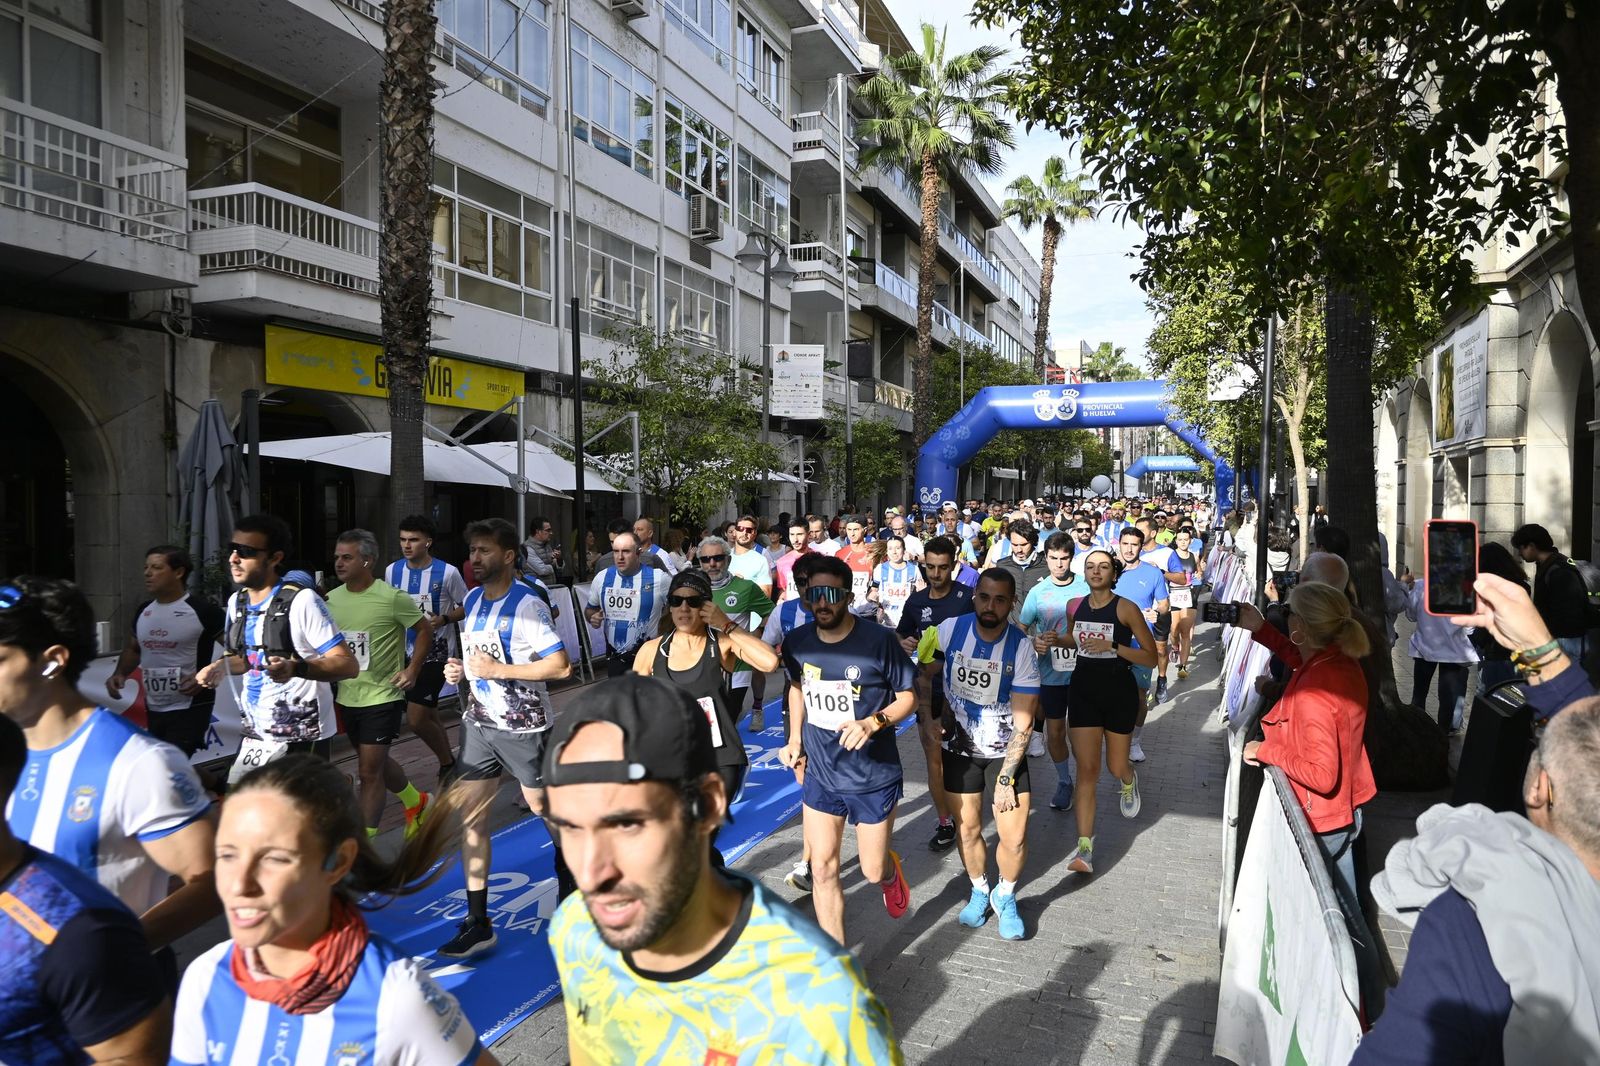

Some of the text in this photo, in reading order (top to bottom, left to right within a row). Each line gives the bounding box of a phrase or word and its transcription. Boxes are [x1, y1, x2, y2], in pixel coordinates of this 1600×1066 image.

[887, 588, 907, 597] 944
[608, 596, 633, 609] 909
[144, 677, 179, 692] 1075
[957, 666, 992, 689] 959
[806, 690, 850, 713] 1108
